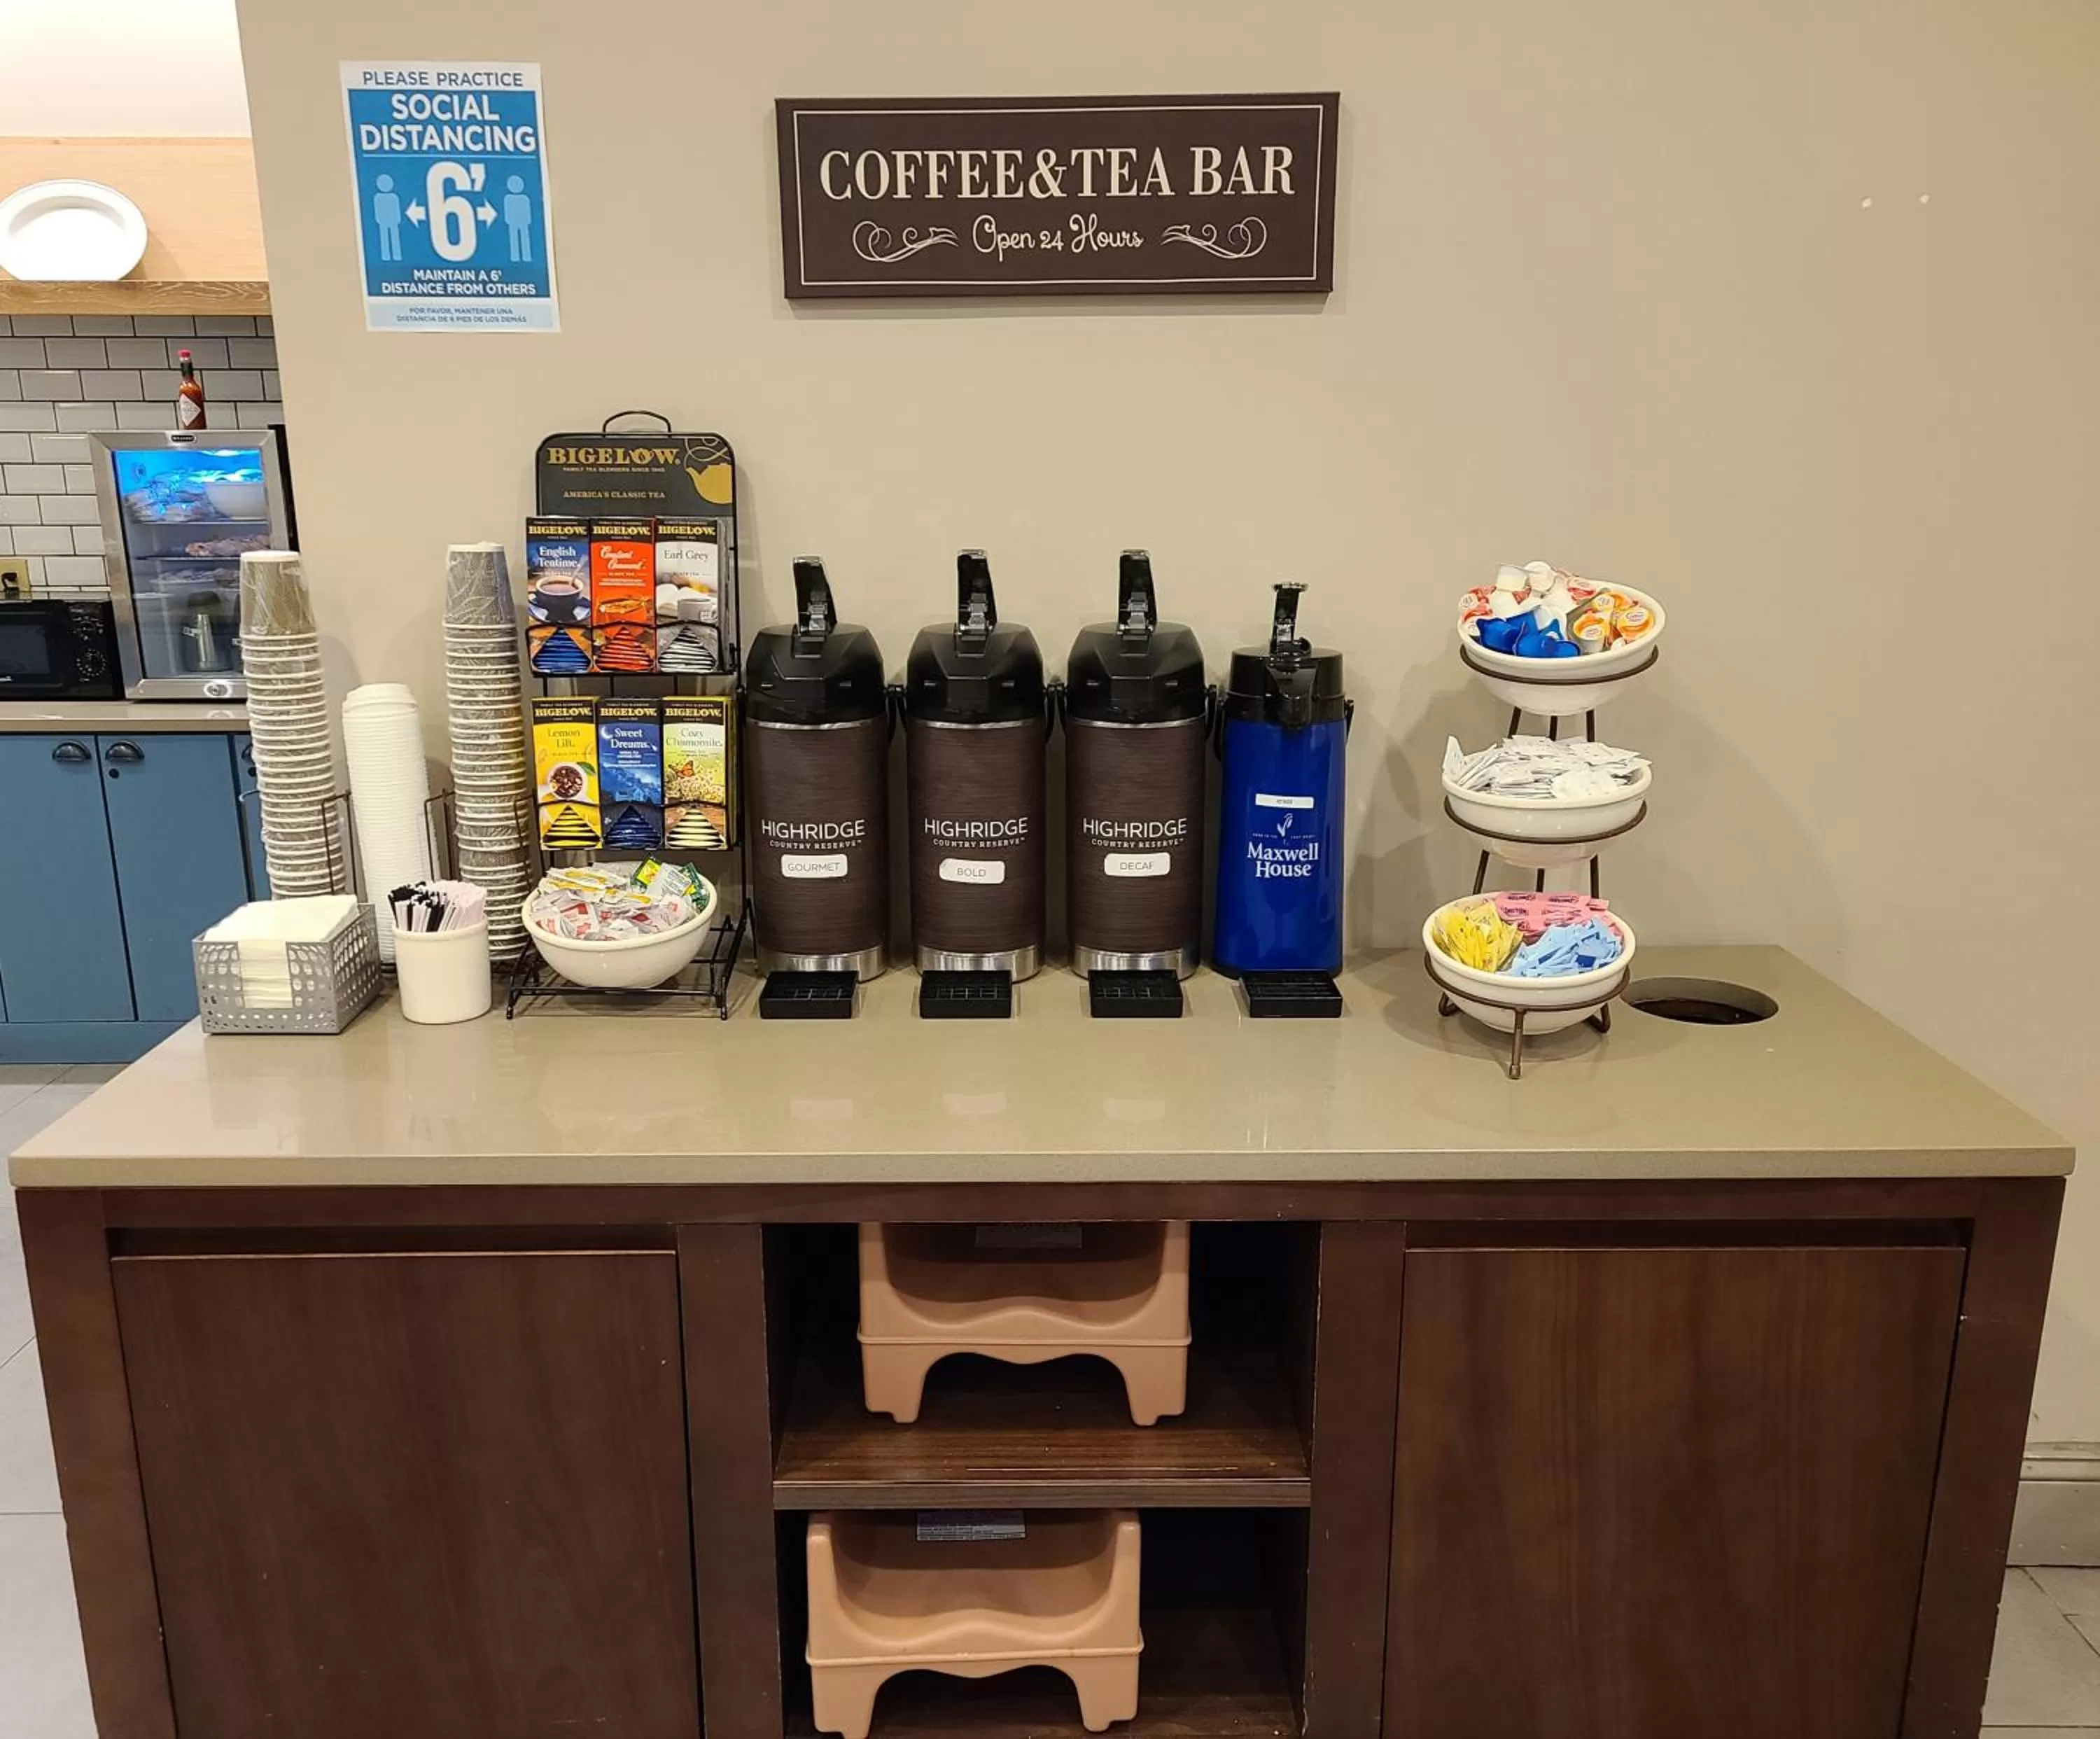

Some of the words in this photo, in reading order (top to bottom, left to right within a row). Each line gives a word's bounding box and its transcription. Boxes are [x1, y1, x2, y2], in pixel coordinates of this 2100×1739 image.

[363, 71, 429, 86] PLEASE
[437, 71, 524, 88] PRACTICE
[391, 93, 500, 120] SOCIAL
[360, 124, 537, 152] DISTANCING
[1189, 145, 1295, 197] BAR
[972, 214, 1036, 262] Open
[1040, 231, 1064, 252] 24
[1069, 212, 1144, 252] Hours
[413, 269, 475, 281] MAINTAIN
[478, 270, 488, 281] A
[382, 282, 444, 294] DISTANCE
[447, 282, 484, 295] FROM
[486, 283, 536, 295] OTHERS
[563, 491, 609, 499] AMERICA'S
[611, 491, 647, 499] CLASSIC
[648, 491, 666, 499] TEA
[538, 545, 576, 559] English
[547, 728, 580, 737] Lemon
[614, 727, 643, 738] Sweet
[761, 818, 866, 840] HIGHRIDGE
[925, 817, 1029, 839] HIGHRIDGE
[1082, 817, 1188, 839] HIGHRIDGE
[769, 839, 812, 849] COUNTRY
[933, 838, 977, 848] COUNTRY
[1091, 838, 1135, 848] COUNTRY
[1247, 841, 1320, 862] Maxwell
[787, 862, 841, 872] GOURMET
[1119, 860, 1155, 871] DECAF
[1255, 860, 1312, 879] House
[956, 867, 986, 878] BOLD
